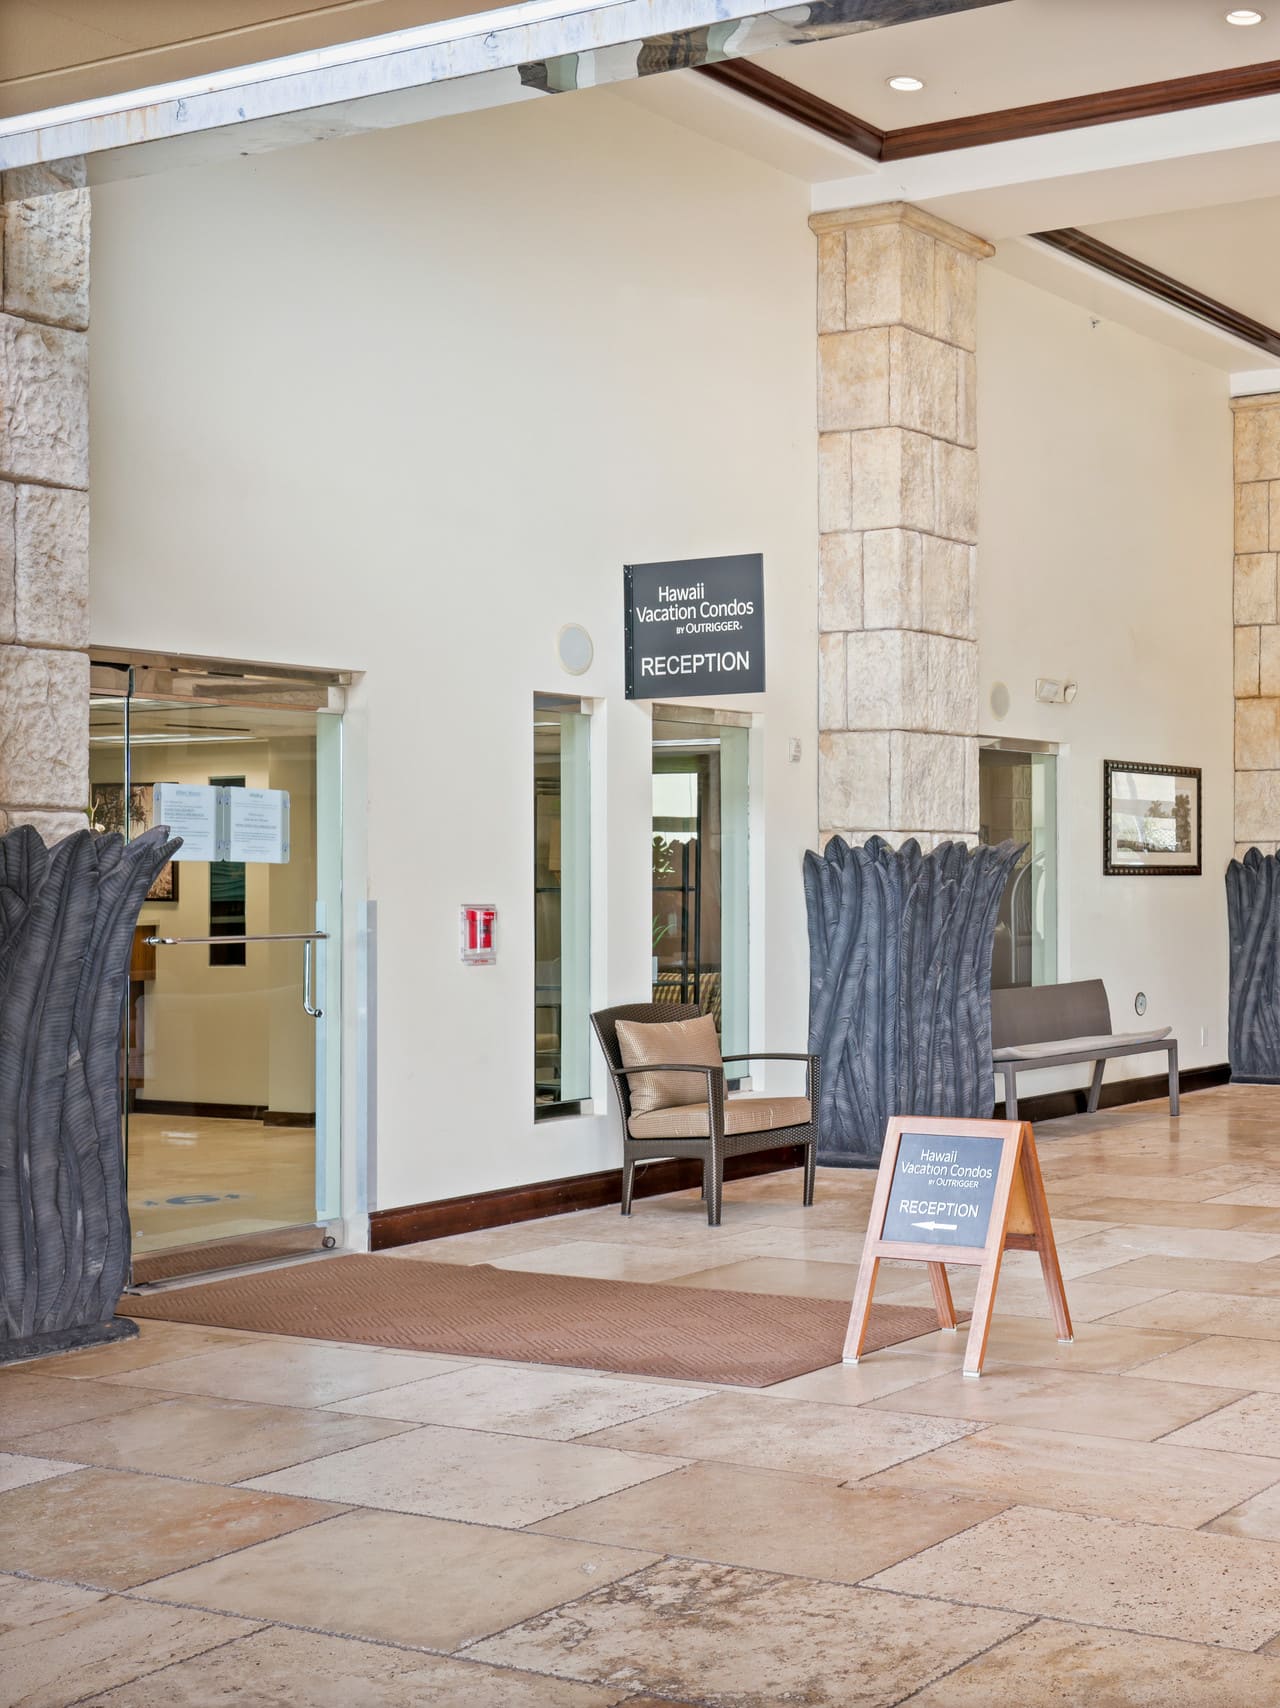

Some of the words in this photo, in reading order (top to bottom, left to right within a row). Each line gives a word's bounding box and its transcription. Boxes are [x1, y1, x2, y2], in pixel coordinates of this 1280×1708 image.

[658, 582, 705, 603] Hawaii
[636, 604, 697, 623] Vacation
[699, 599, 754, 618] Condos
[676, 626, 685, 635] BY
[685, 620, 740, 634] OUTRIGGER
[641, 650, 750, 677] RECEPTION
[920, 1148, 958, 1163] Hawaii
[901, 1161, 948, 1176] Vacation
[950, 1164, 993, 1179] Condos
[936, 1177, 979, 1188] OUTRIGGER
[899, 1199, 979, 1218] RECEPTION
